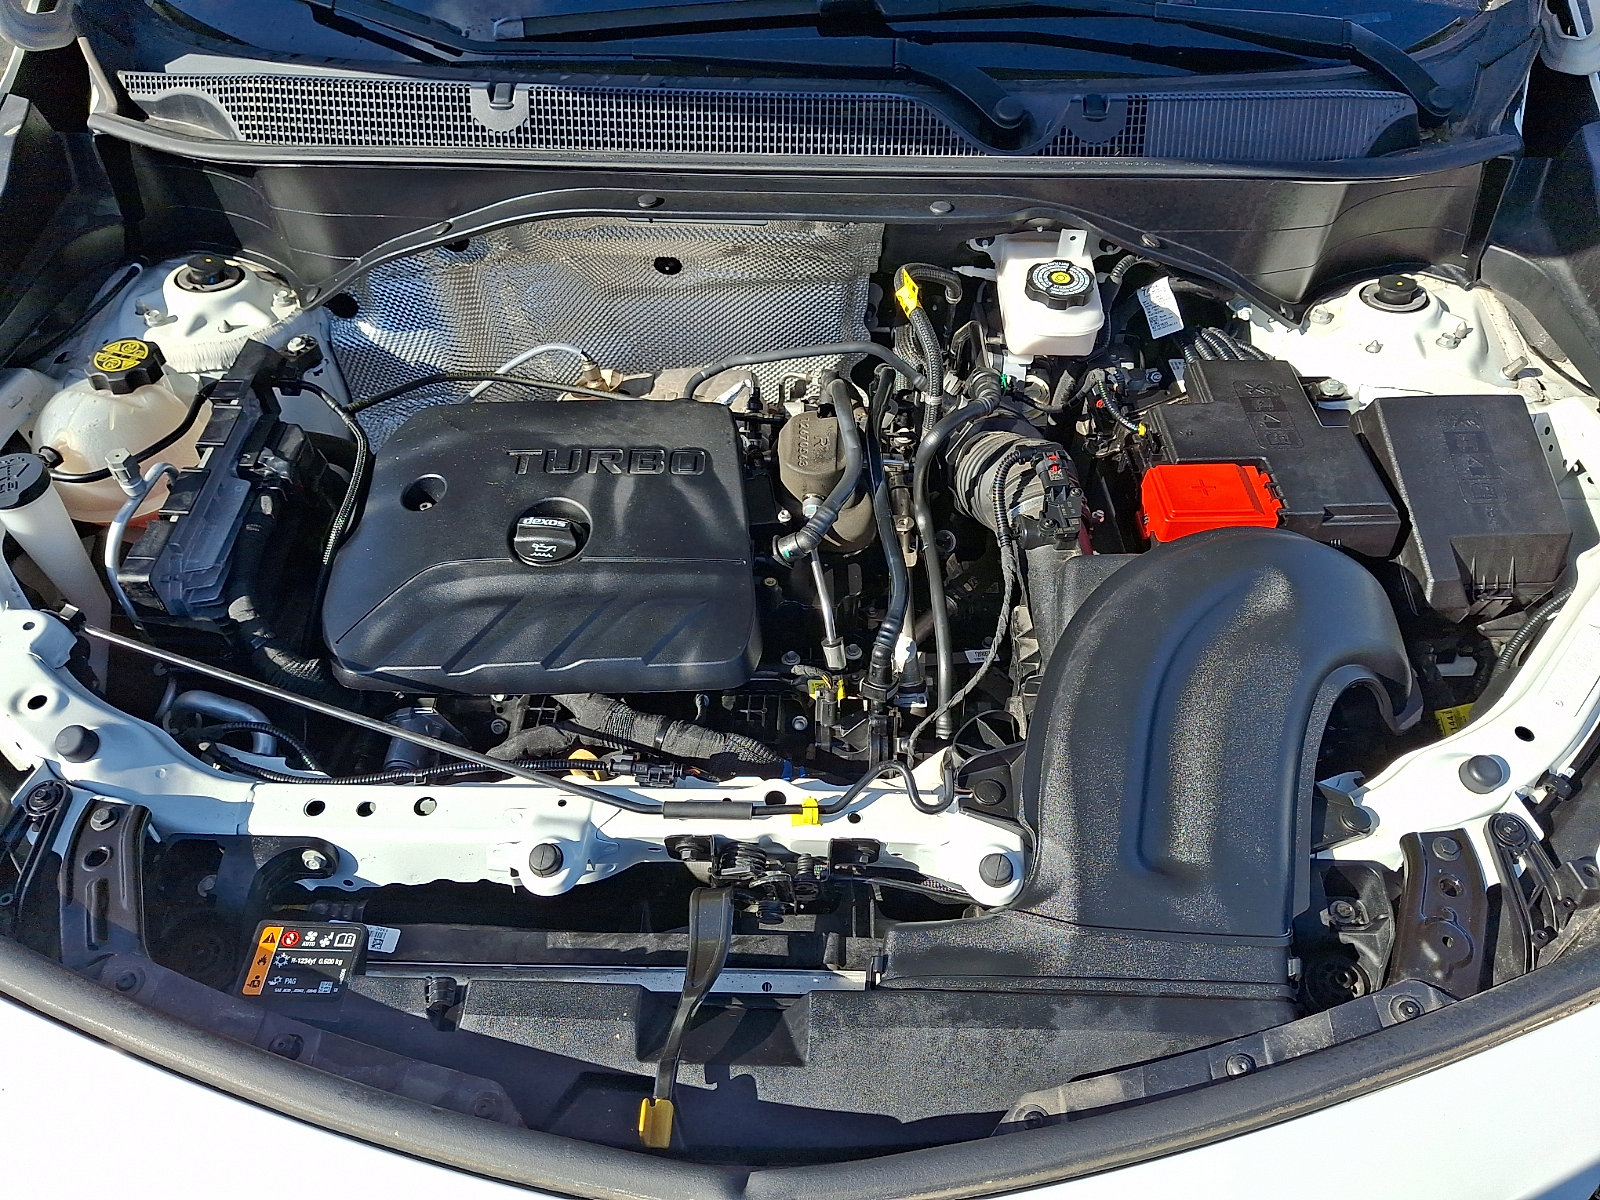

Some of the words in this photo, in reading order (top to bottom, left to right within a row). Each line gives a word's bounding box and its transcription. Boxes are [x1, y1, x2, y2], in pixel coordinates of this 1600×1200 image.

[506, 447, 706, 476] TURBO
[522, 516, 569, 528] dexos
[335, 958, 344, 966] kg
[284, 977, 297, 985] PAG
